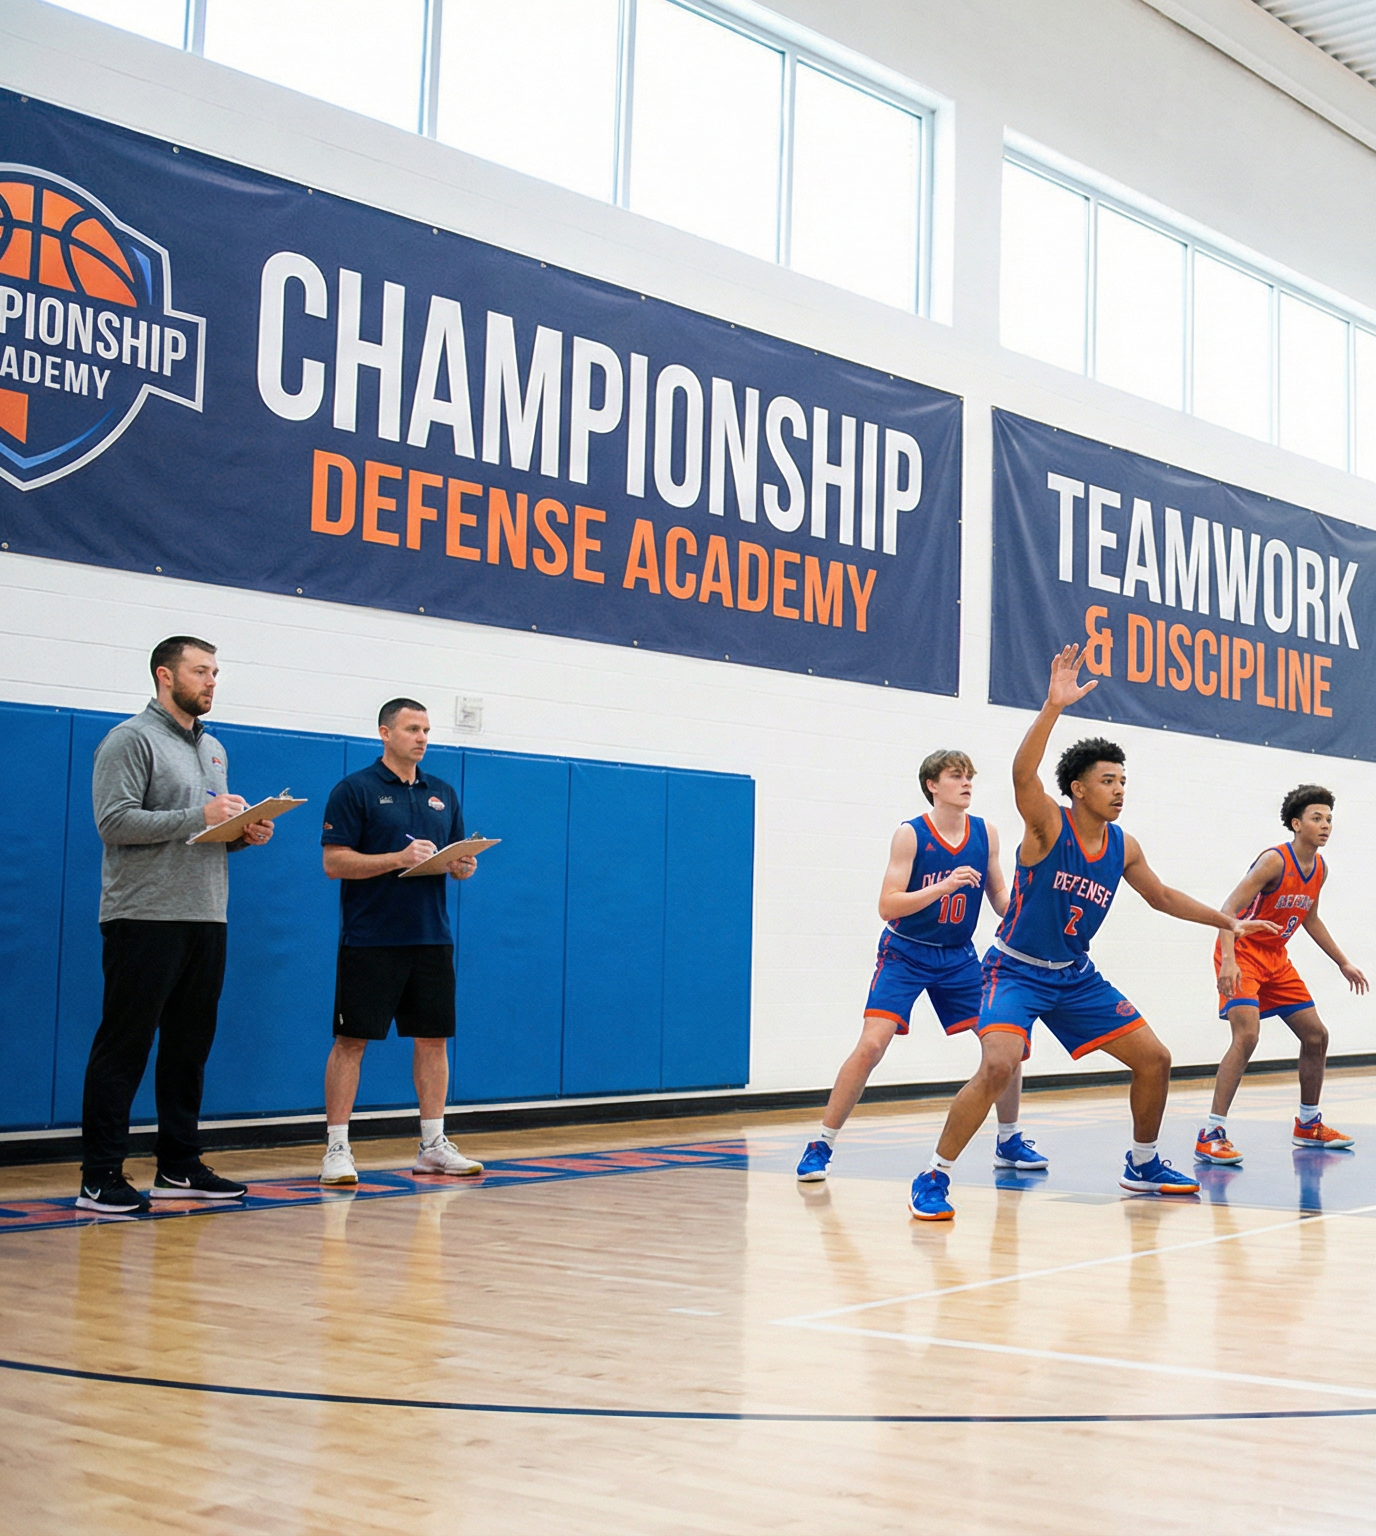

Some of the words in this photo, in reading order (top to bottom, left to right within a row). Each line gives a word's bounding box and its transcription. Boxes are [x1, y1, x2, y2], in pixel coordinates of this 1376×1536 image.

[257, 251, 924, 556] CHAMPIONSHIP
[311, 449, 606, 584] DEFENSE
[622, 518, 877, 632] ACADEMY
[1047, 471, 1360, 650] TEAMWORK
[1085, 605, 1114, 678] &
[1127, 612, 1333, 718] DISCIPLINE
[937, 893, 967, 924] 10
[1063, 904, 1084, 936] 2
